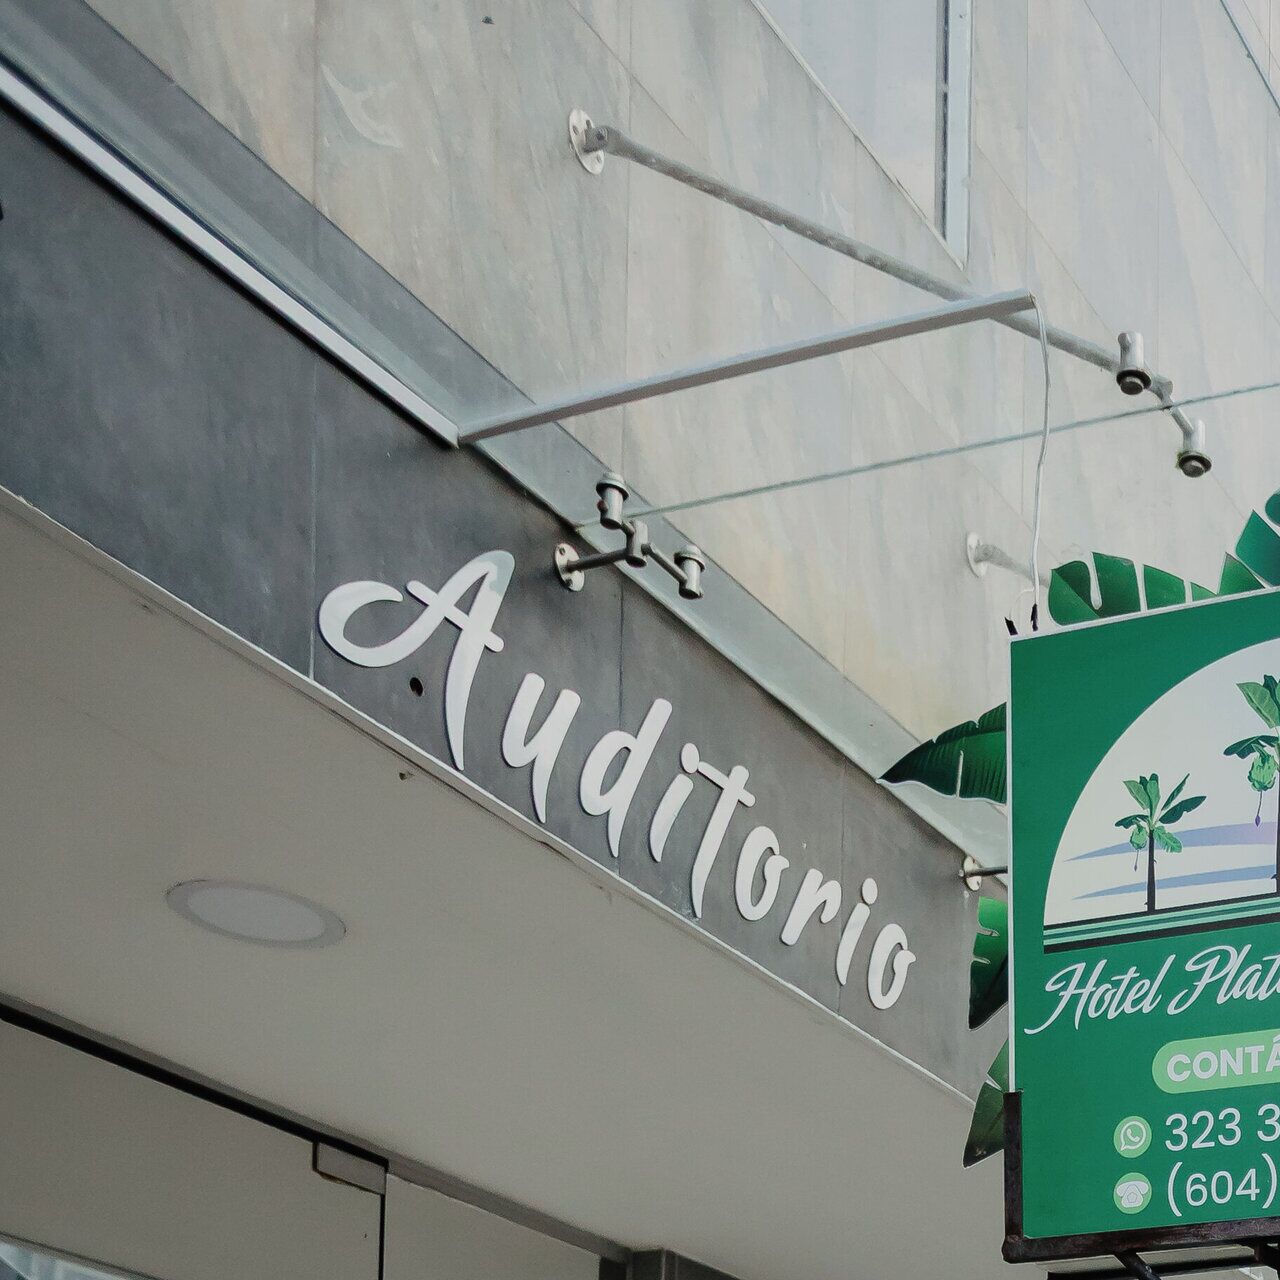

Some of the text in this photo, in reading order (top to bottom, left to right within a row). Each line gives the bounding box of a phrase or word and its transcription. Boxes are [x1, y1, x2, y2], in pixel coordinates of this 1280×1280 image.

[319, 550, 916, 1009] Auditorio
[1024, 954, 1177, 1035] Hotel
[1165, 1107, 1242, 1152] 323
[1167, 1152, 1278, 1217] (604)
